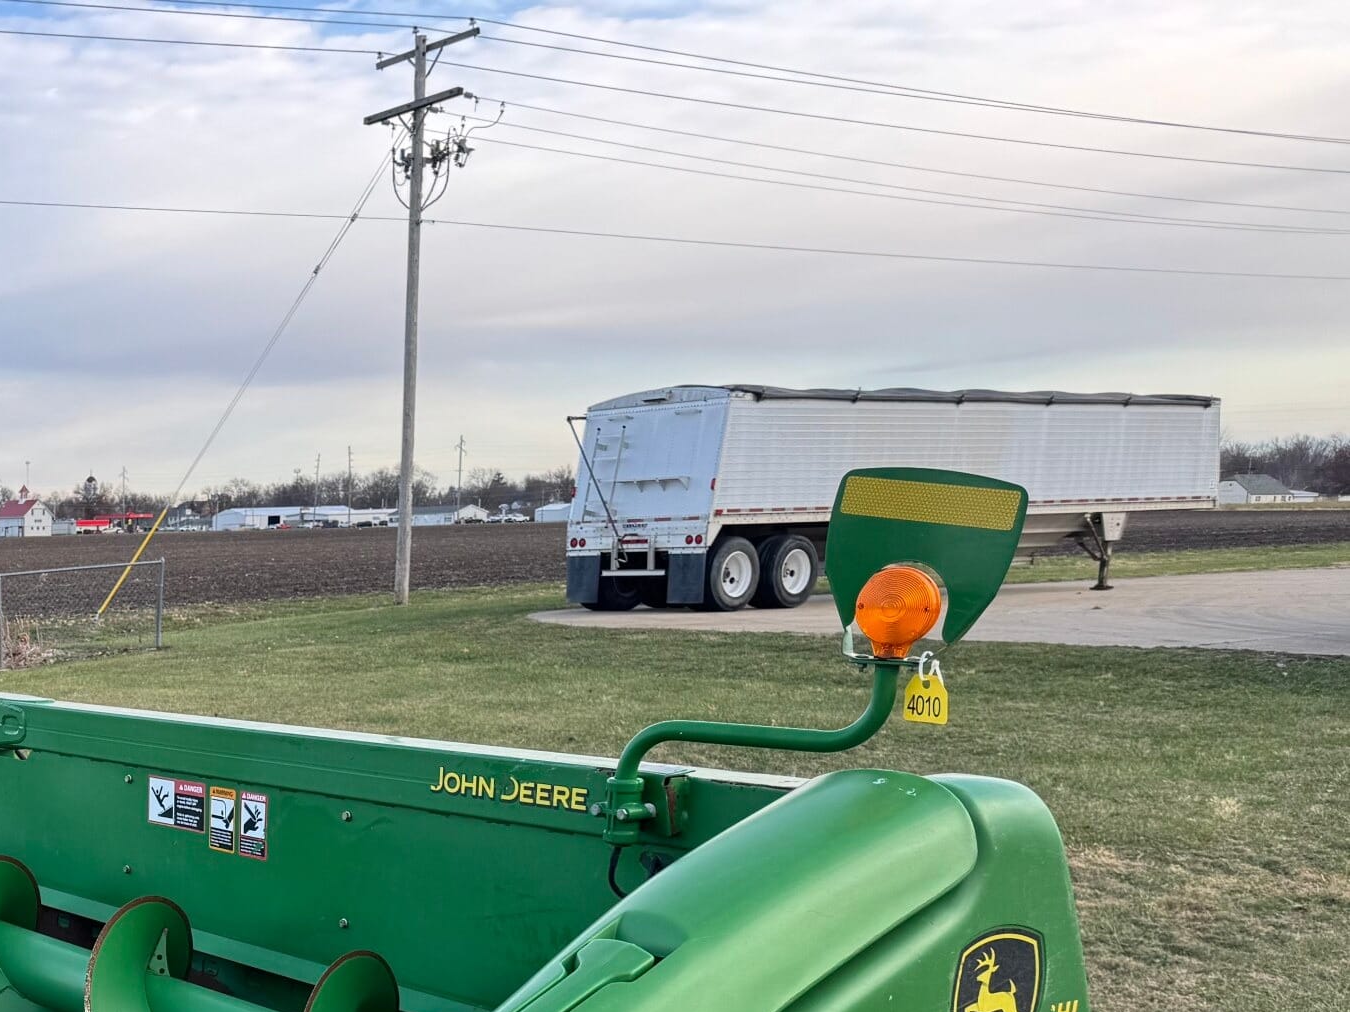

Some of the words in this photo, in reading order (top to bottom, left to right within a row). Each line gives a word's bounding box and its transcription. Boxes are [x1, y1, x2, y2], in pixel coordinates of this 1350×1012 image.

[907, 694, 941, 717] 4010
[183, 784, 203, 794] DANGER
[430, 766, 495, 799] JOHN
[500, 776, 588, 811] DEERE
[246, 792, 267, 802] DANGER
